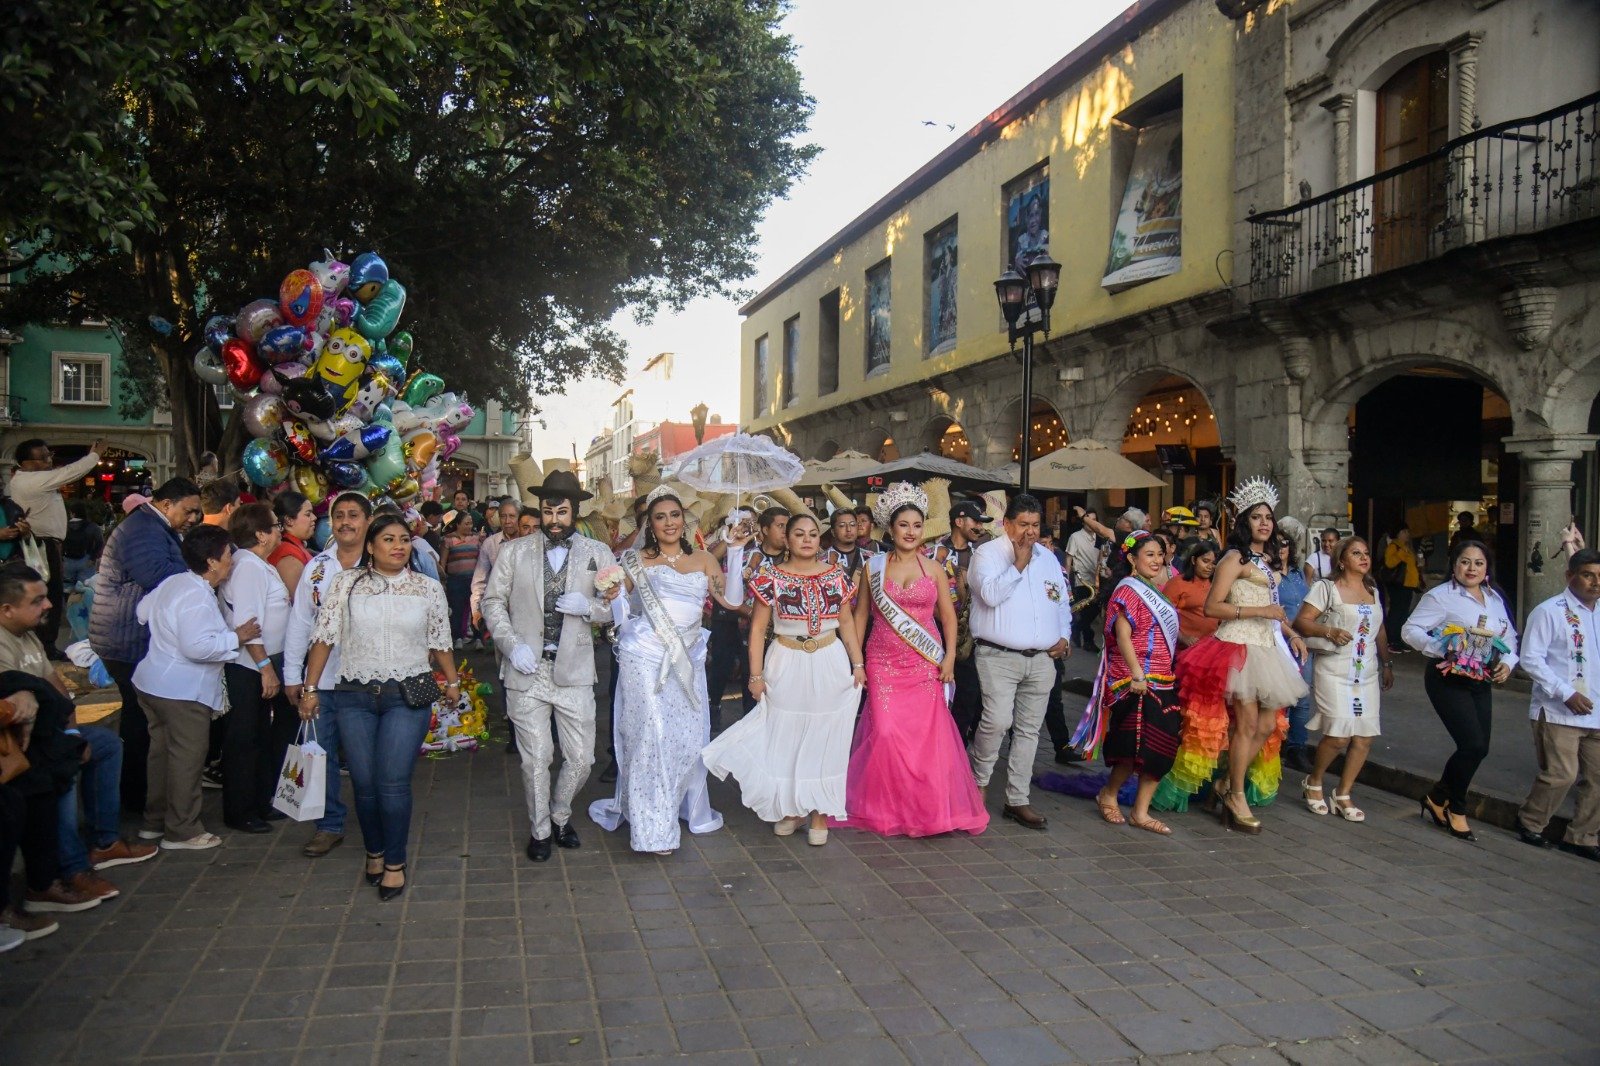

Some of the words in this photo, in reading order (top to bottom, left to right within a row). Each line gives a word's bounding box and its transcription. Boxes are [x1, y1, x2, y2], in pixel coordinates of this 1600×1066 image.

[639, 582, 658, 613] 2026
[1142, 589, 1162, 610] DIOSA
[1158, 605, 1171, 619] DE
[870, 570, 884, 606] REINA
[880, 601, 899, 625] DEL
[897, 620, 941, 661] CARNAVAL
